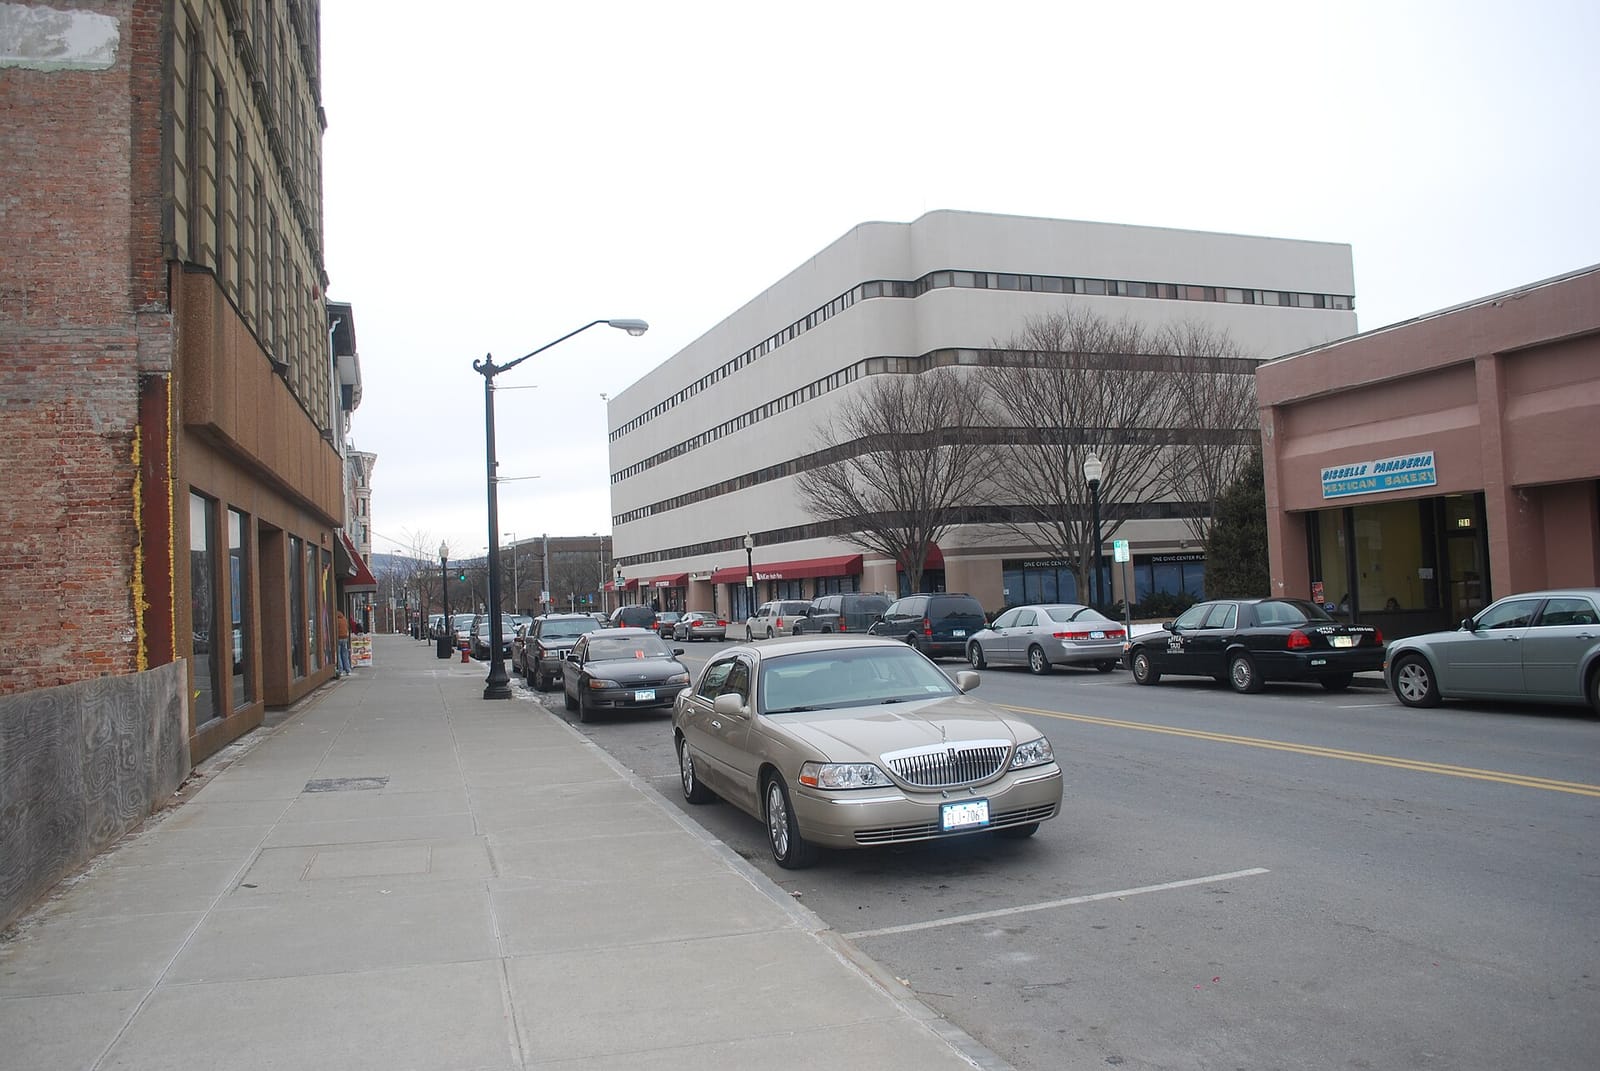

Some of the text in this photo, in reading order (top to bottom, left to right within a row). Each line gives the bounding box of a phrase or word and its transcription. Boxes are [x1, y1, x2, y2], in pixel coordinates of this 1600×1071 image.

[1373, 456, 1431, 473] PANADERIA
[1323, 471, 1434, 493] MEXICAN BAKERY
